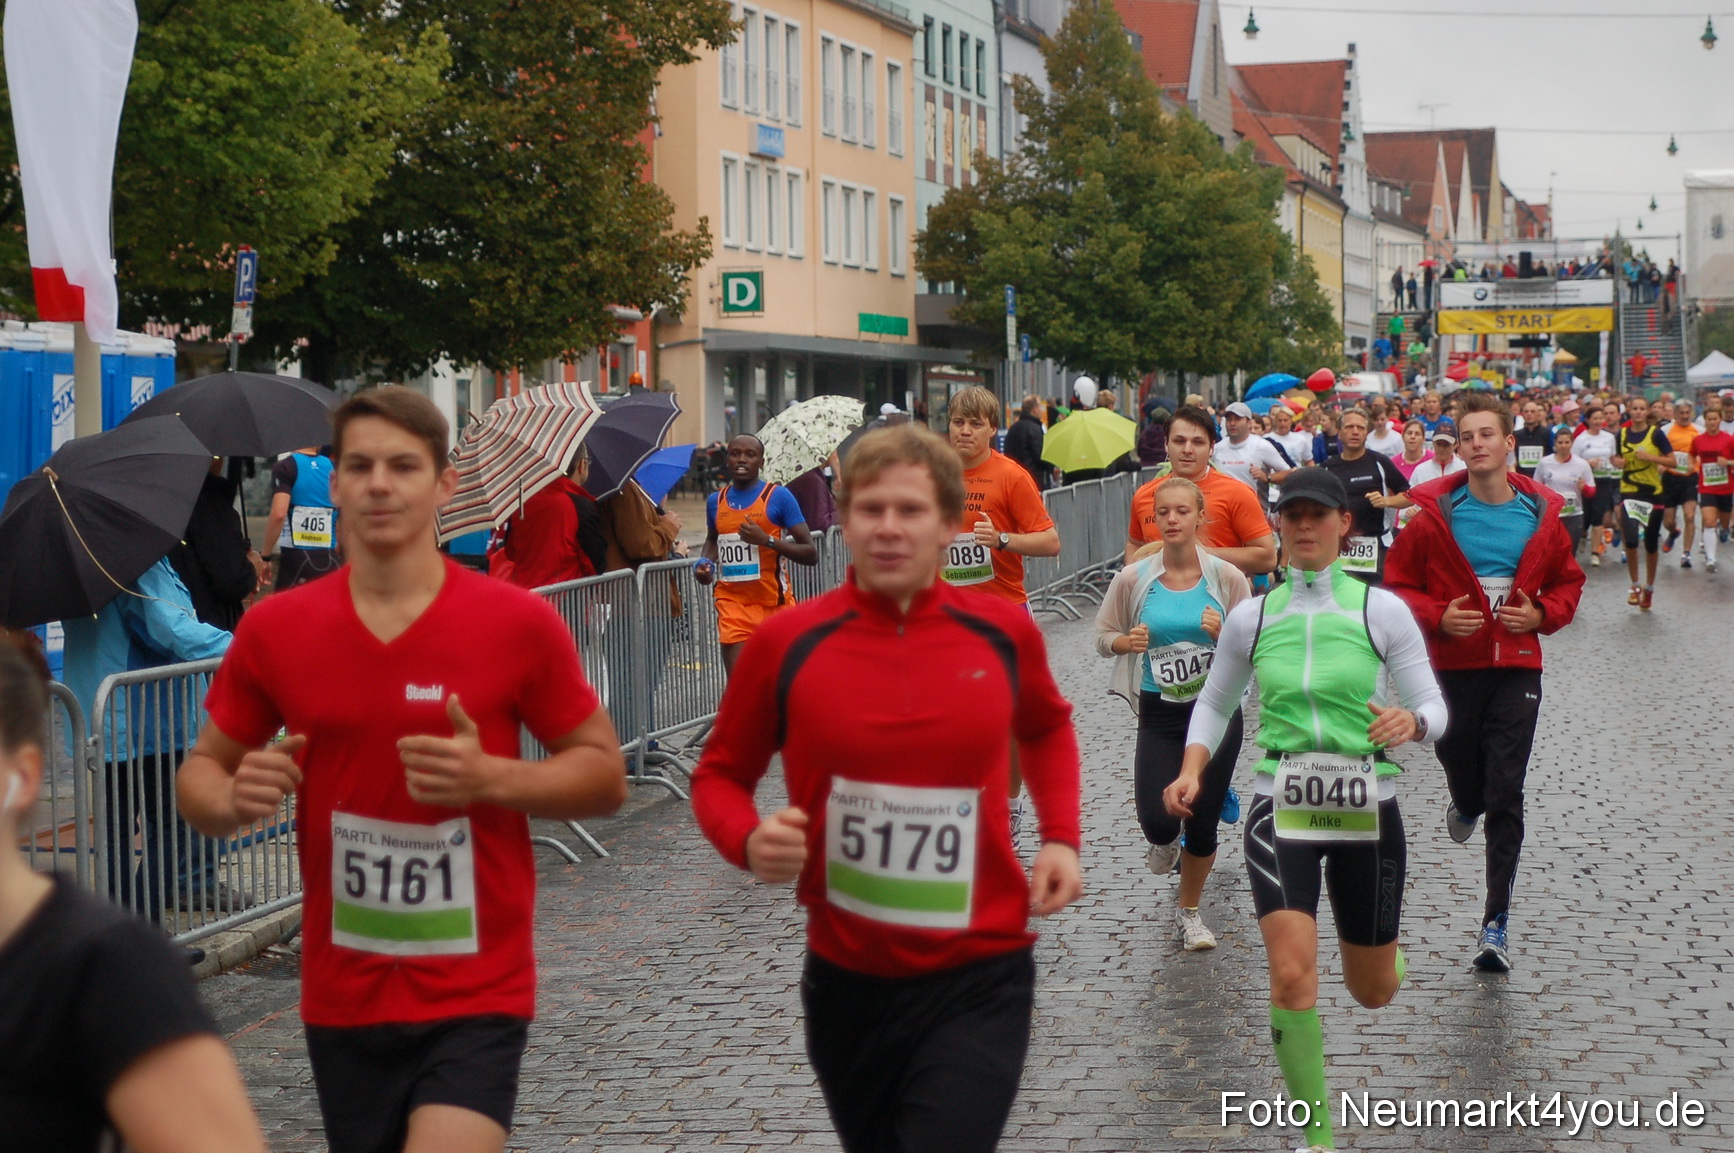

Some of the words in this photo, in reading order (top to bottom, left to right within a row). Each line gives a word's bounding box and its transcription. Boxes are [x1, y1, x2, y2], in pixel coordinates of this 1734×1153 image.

[239, 257, 253, 297] P
[728, 277, 757, 307] D
[1495, 313, 1554, 329] START
[301, 517, 325, 531] 405
[720, 544, 753, 563] 2001
[945, 544, 985, 566] 089
[1342, 544, 1374, 558] 093
[945, 569, 982, 580] Sebastian
[1151, 650, 1174, 662] PARTL
[1160, 651, 1214, 684] 5047
[1280, 761, 1309, 771] PARTL
[1311, 763, 1358, 772] Neumarkt
[1284, 774, 1368, 809] 5040
[831, 791, 878, 811] PARTL
[882, 801, 951, 817] Neumarkt
[1309, 814, 1341, 828] Anke
[334, 826, 377, 845] PARTL
[381, 834, 447, 851] Neumarkt
[840, 813, 962, 874] 5179
[344, 849, 454, 906] 5161
